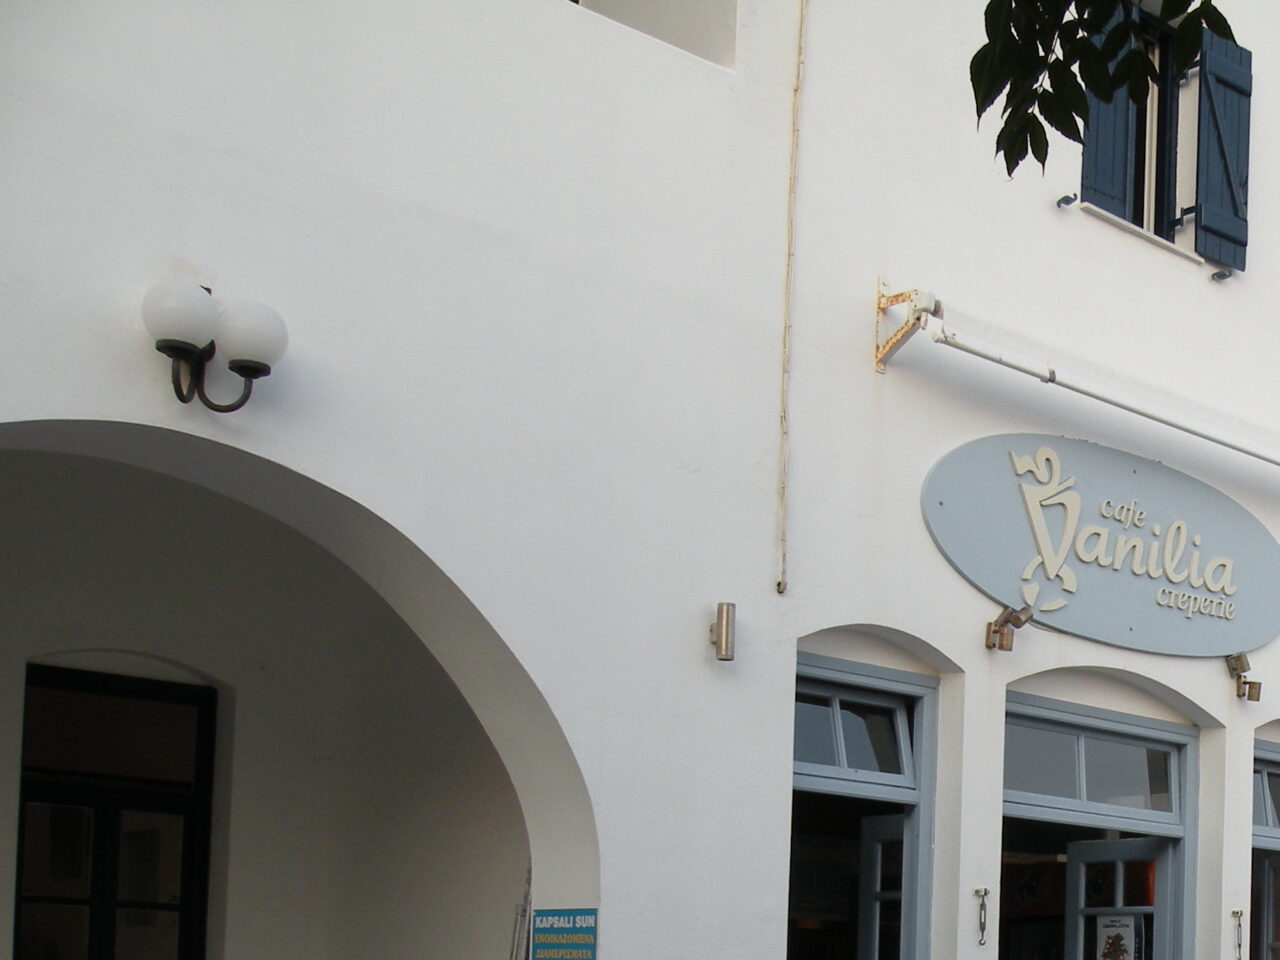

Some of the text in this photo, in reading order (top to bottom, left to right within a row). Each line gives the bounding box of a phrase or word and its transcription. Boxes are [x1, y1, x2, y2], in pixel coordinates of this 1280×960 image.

[1010, 448, 1238, 597] Vanilia
[1100, 498, 1147, 529] cafe
[1156, 585, 1237, 620] creperie
[535, 915, 595, 928] KAPSALI SUN
